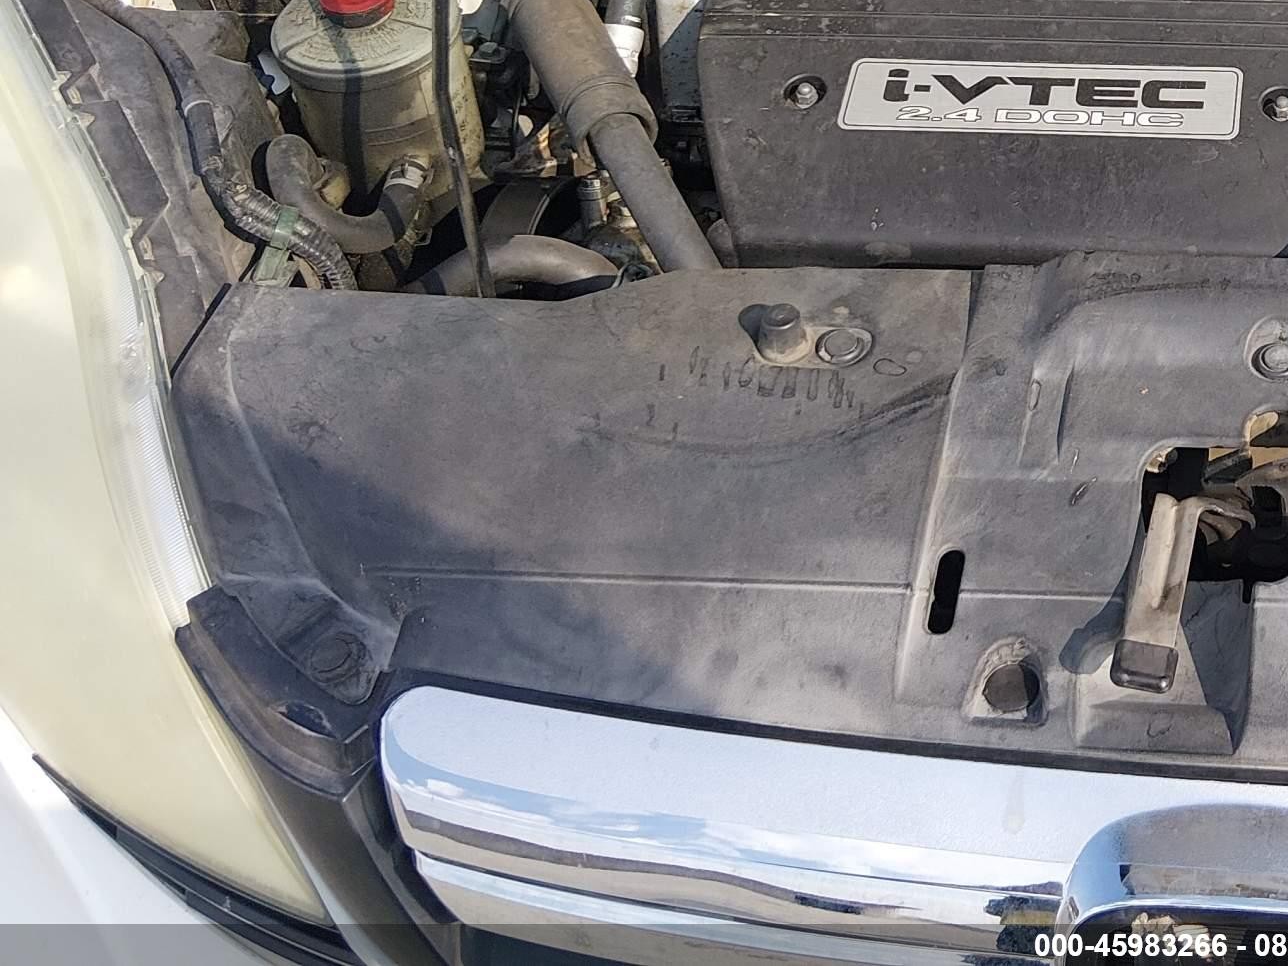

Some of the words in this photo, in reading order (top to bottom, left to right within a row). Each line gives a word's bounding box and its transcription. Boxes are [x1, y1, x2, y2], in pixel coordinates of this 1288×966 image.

[882, 68, 1207, 110] i-VTEC
[896, 105, 982, 123] 2.4
[994, 108, 1185, 128] DOHC
